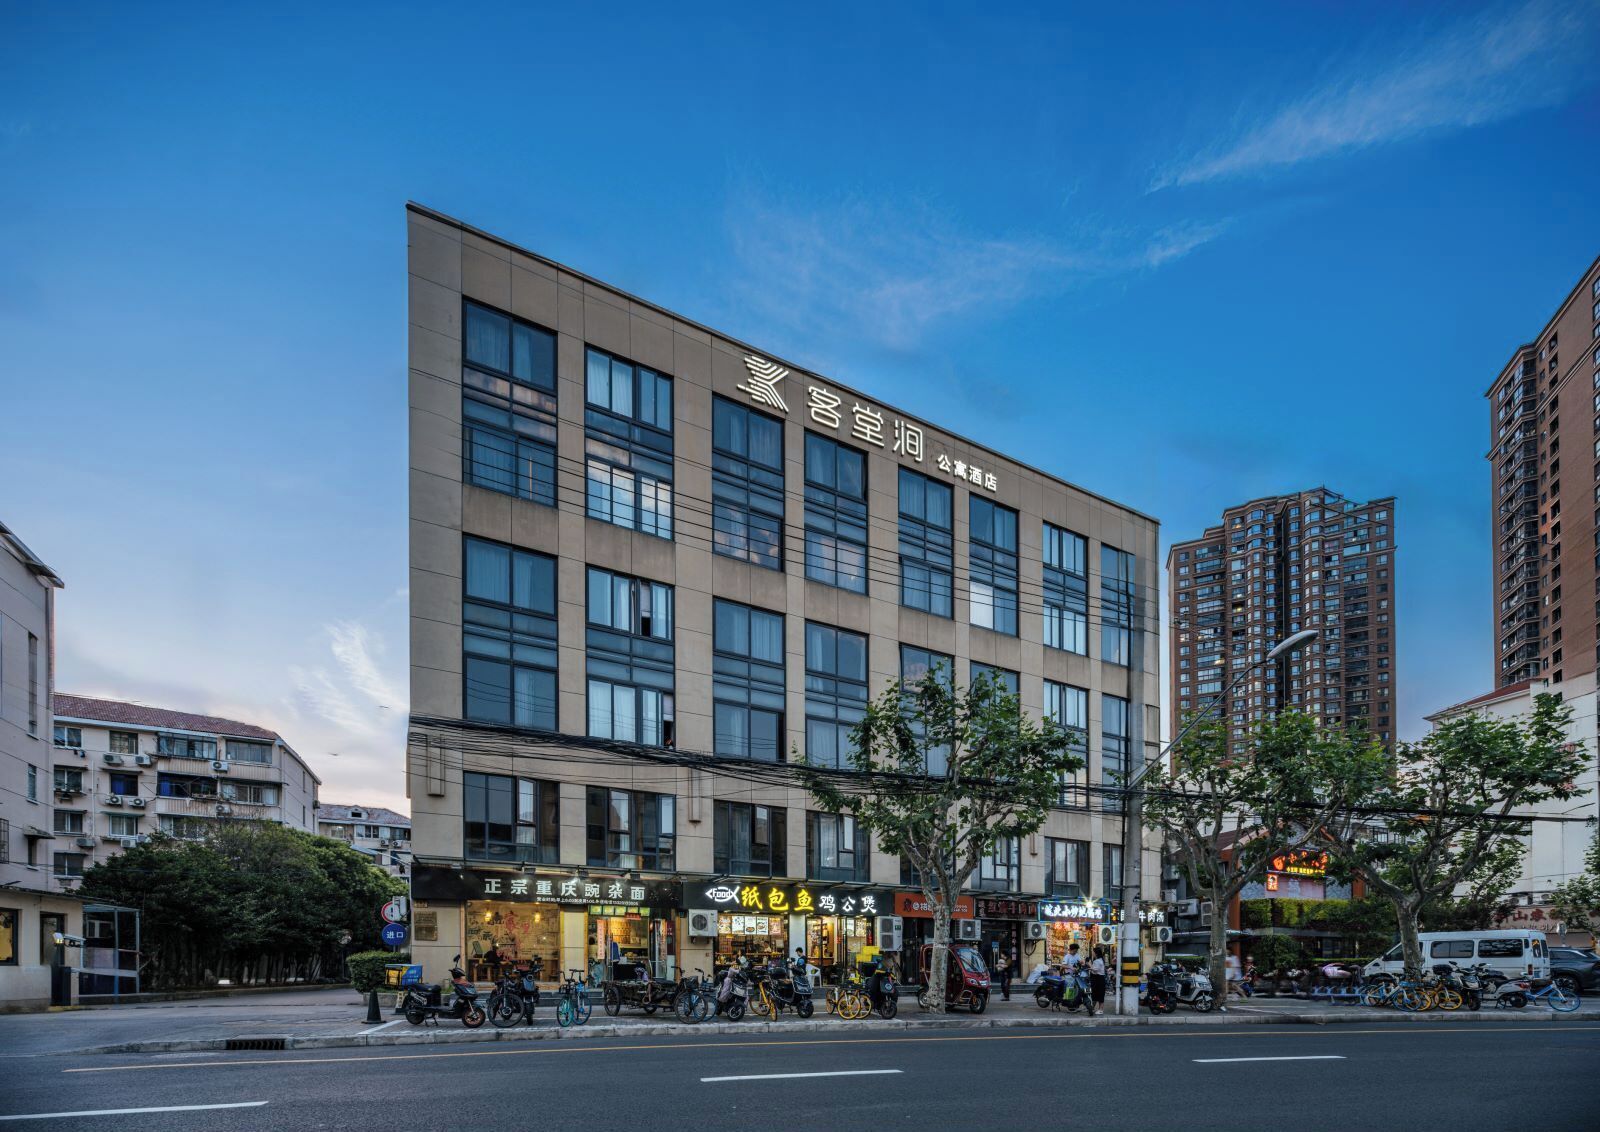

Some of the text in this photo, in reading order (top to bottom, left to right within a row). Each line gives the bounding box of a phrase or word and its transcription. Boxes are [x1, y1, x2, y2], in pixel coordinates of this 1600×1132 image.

[937, 453, 997, 491] 公寓酒店
[484, 878, 646, 900] 正宗重庆豌杂面
[386, 931, 404, 939] 进口
